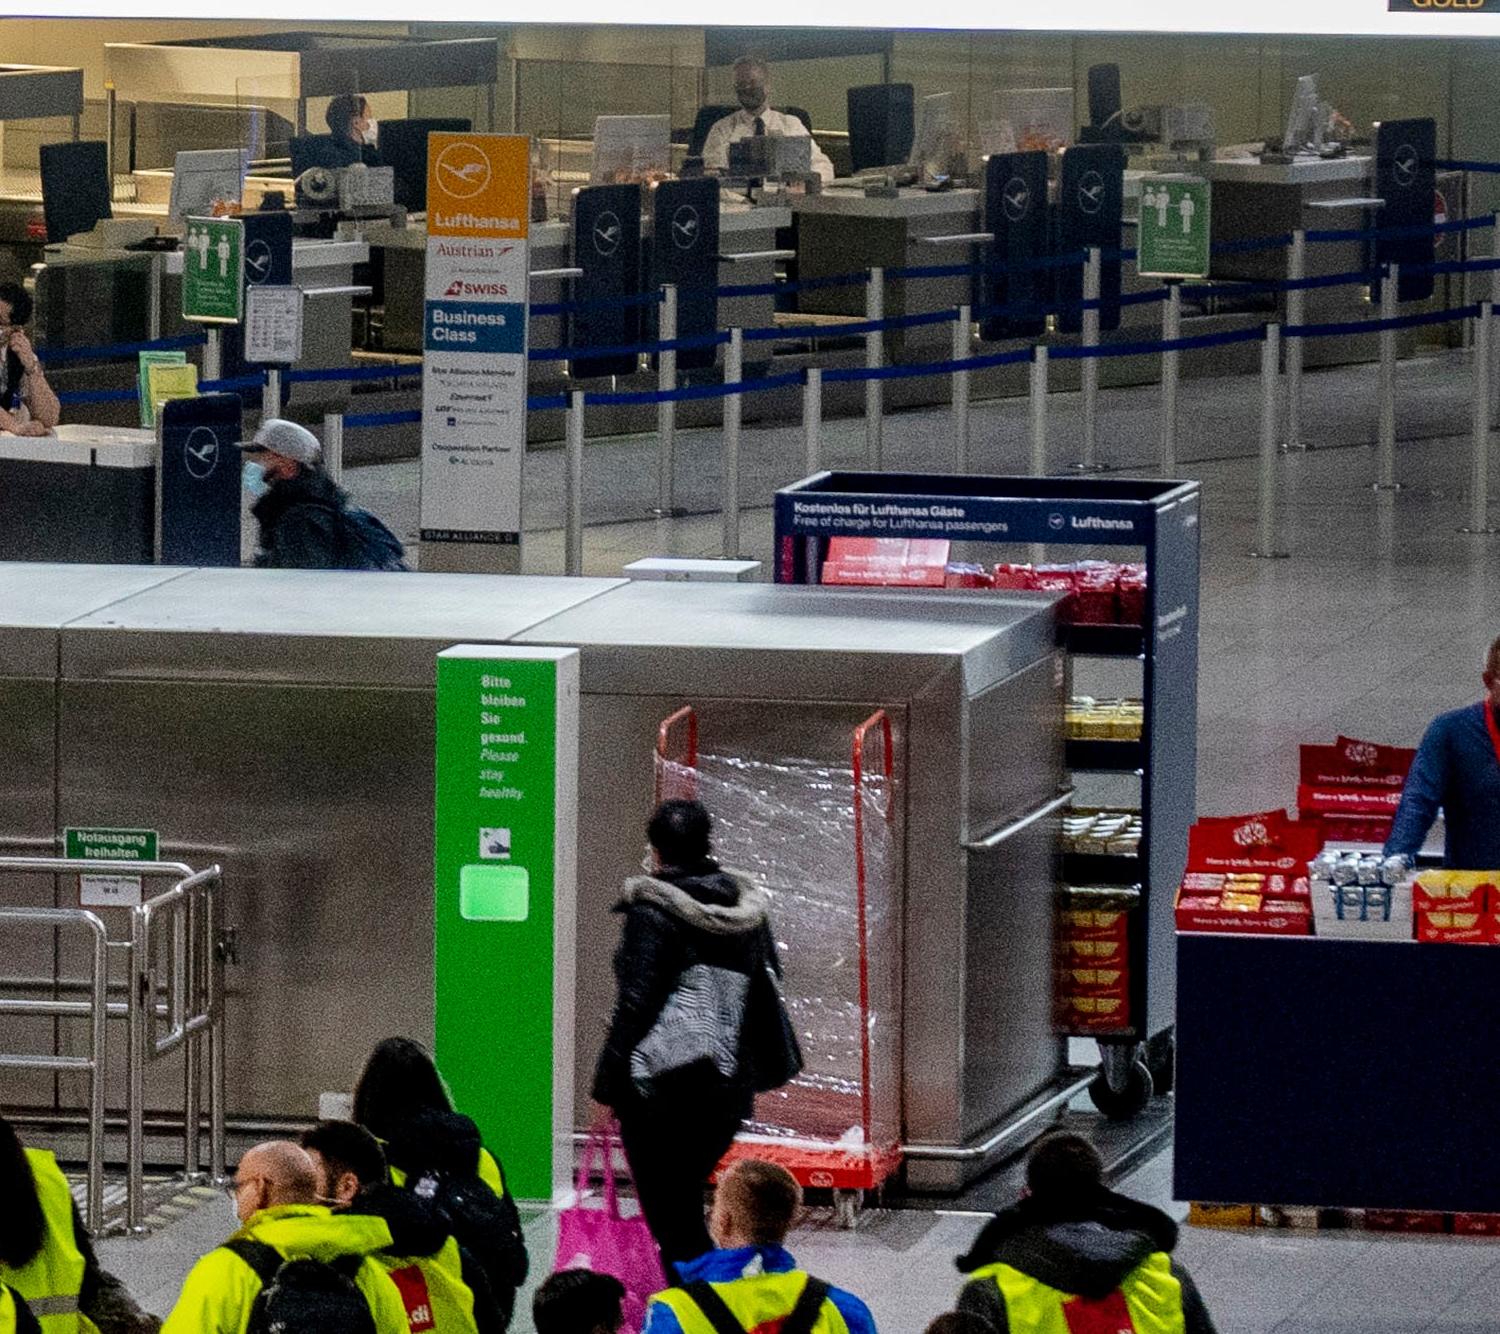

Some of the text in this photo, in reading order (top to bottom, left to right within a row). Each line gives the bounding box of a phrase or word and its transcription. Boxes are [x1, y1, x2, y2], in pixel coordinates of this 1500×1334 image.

[434, 212, 521, 232] Lufthansa
[436, 243, 495, 258] Austrian
[463, 282, 509, 296] SWISS
[431, 308, 507, 327] Business
[431, 327, 478, 344] Class
[793, 501, 966, 518] Kostenlos für Lufthansa Gäste
[1071, 516, 1134, 530] Lufthansa
[480, 674, 512, 689] Bitte
[480, 693, 526, 708] bleiben
[480, 711, 502, 726] Sie
[479, 750, 520, 764] Please
[479, 769, 505, 785] stay
